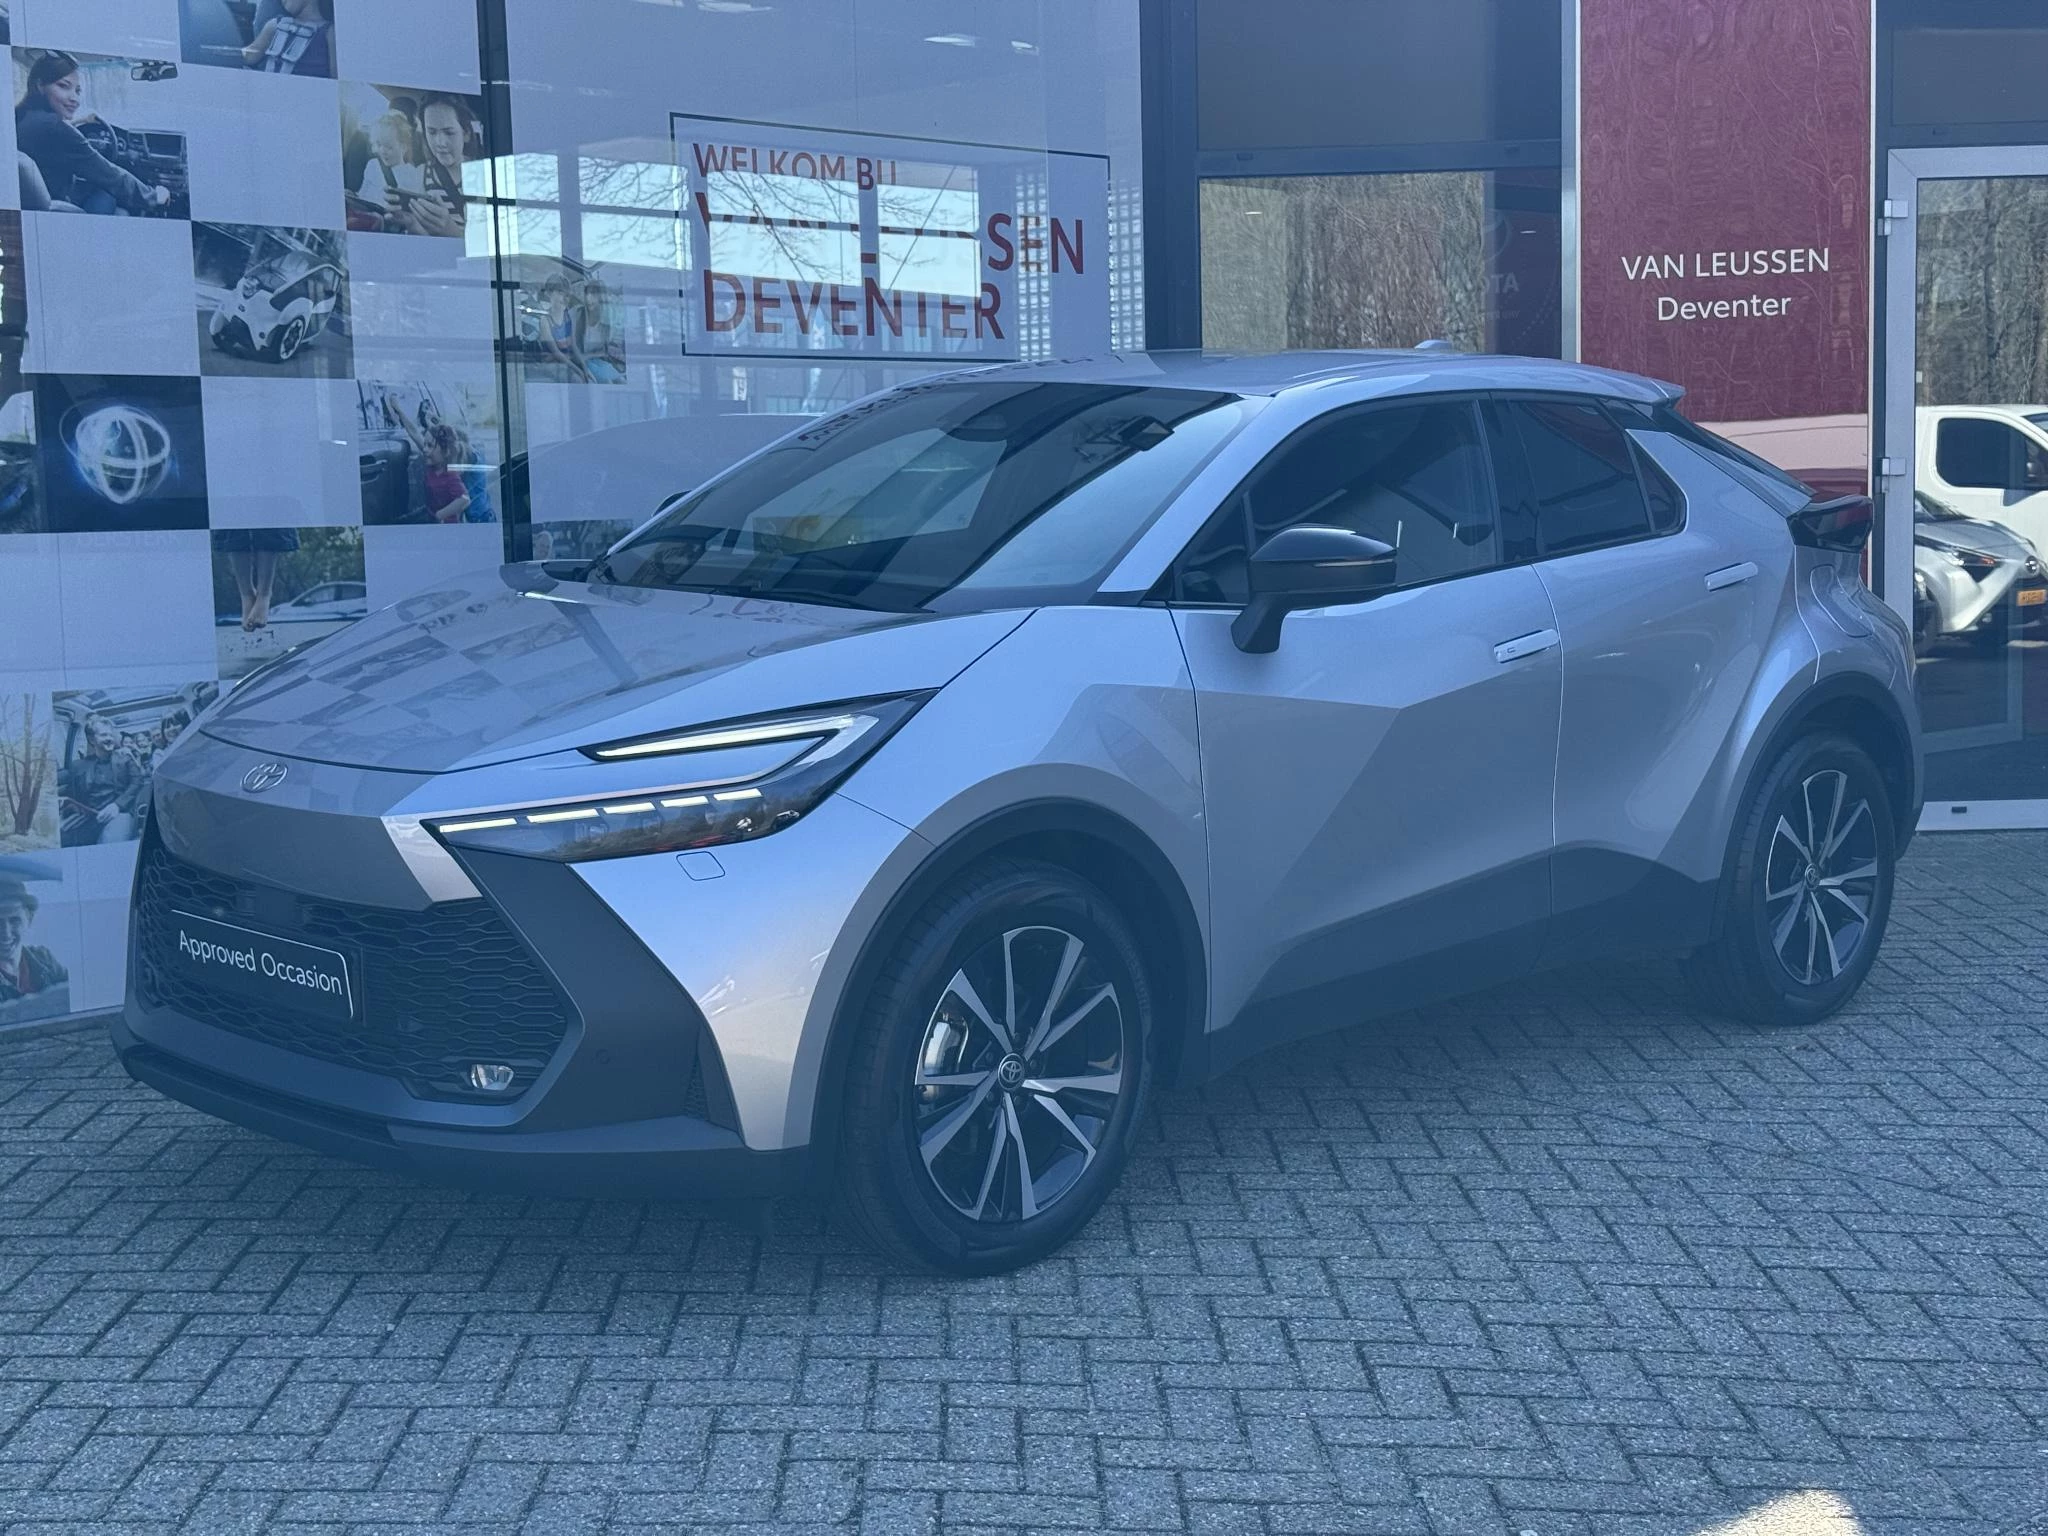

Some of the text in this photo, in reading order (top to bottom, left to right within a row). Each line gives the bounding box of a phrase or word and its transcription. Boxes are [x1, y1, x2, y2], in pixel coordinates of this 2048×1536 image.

[1620, 247, 1830, 281] VAN LEUSSEN
[1657, 293, 1792, 322] Deventer
[179, 929, 343, 996] Approved Occasion
